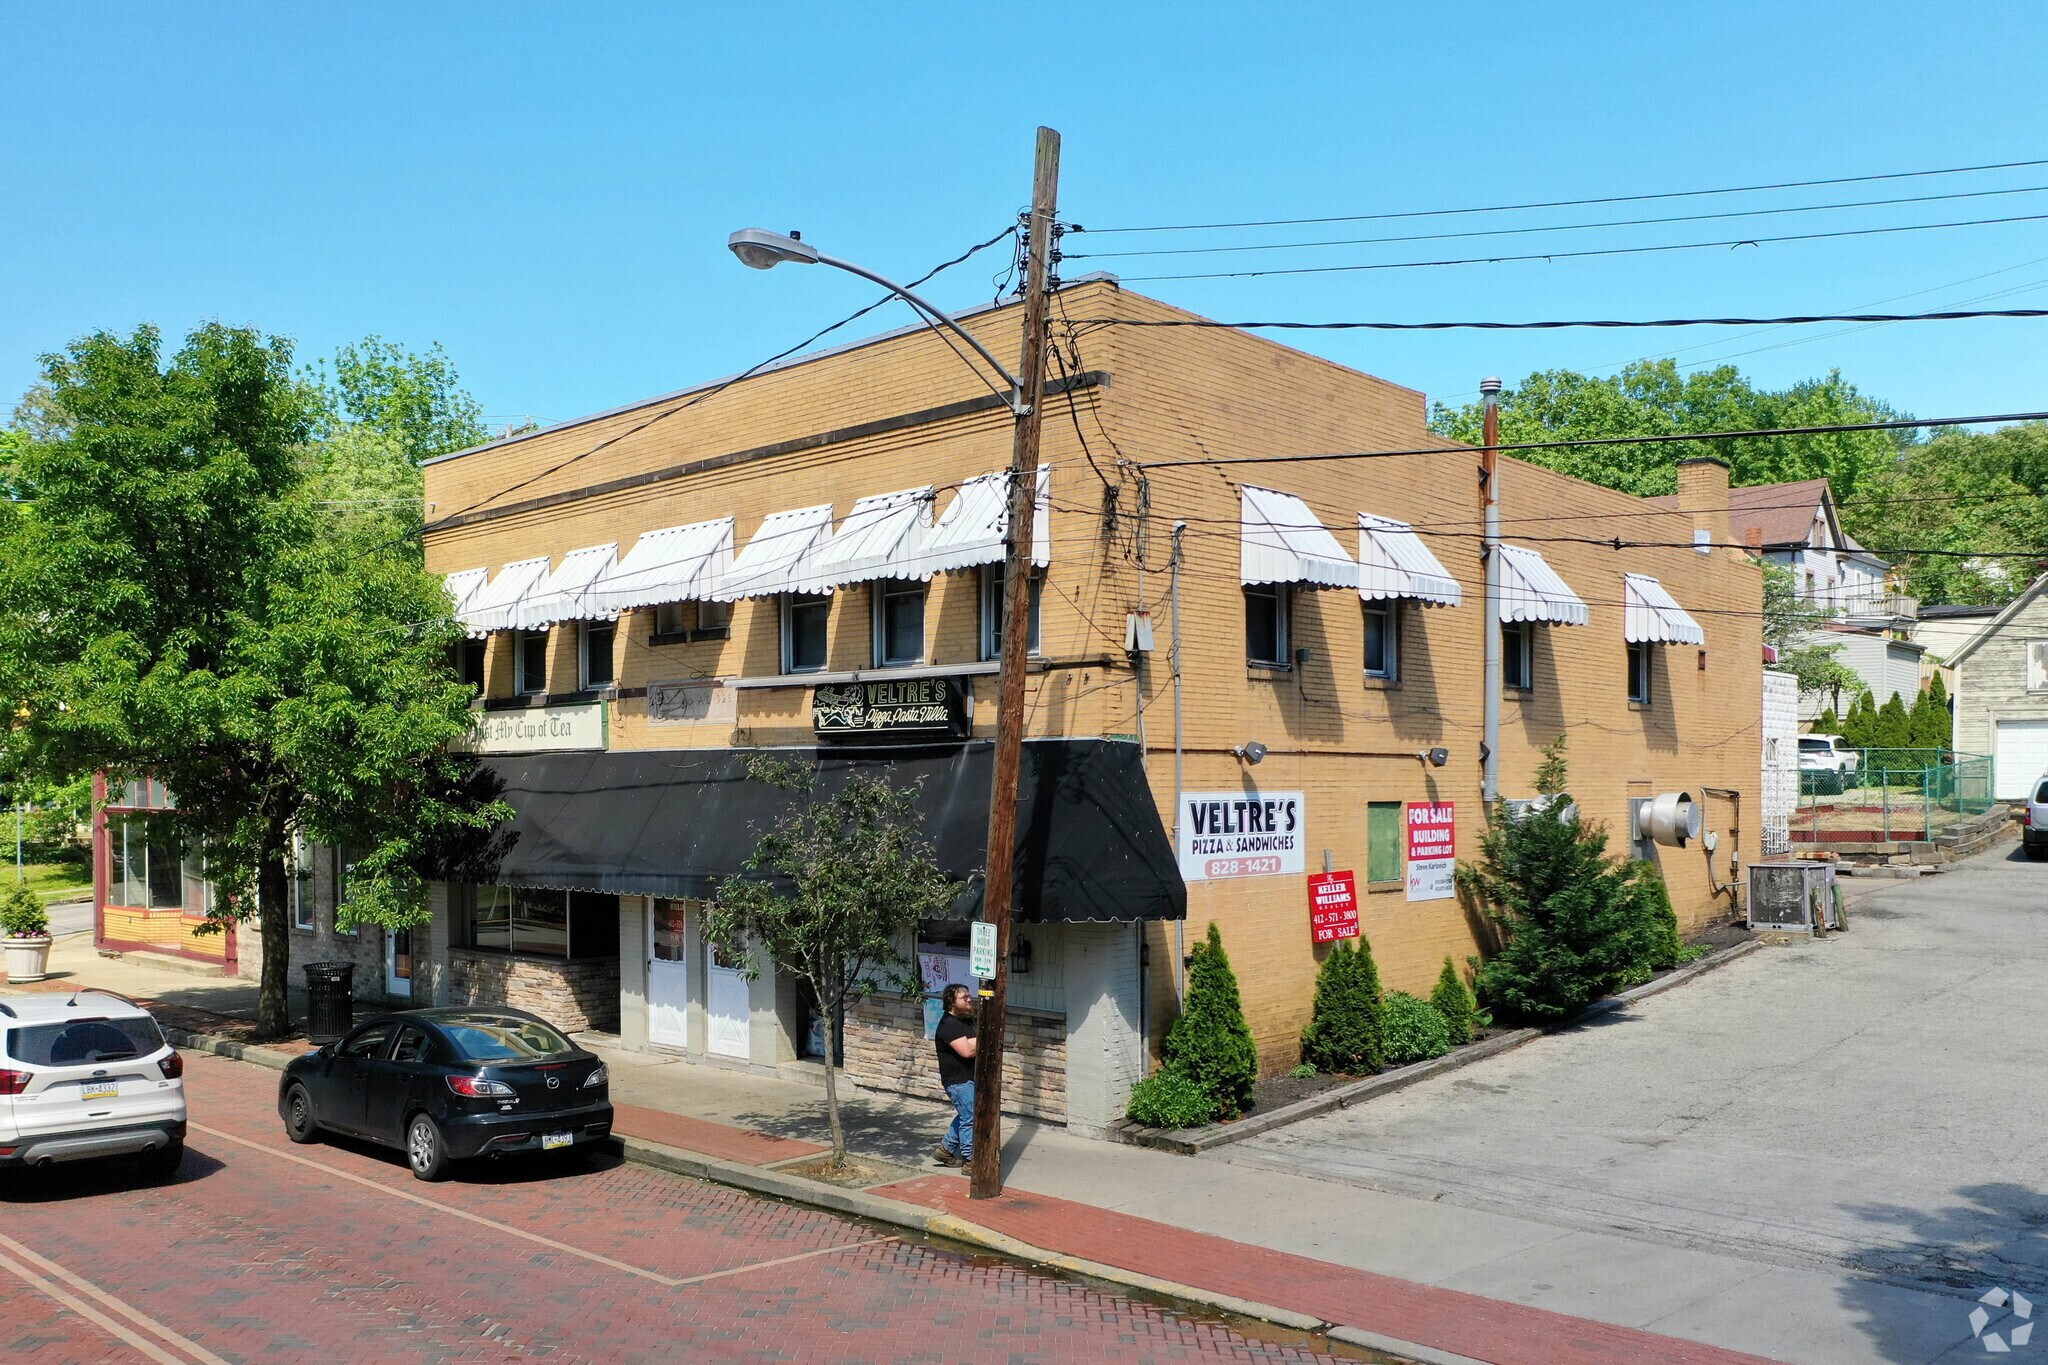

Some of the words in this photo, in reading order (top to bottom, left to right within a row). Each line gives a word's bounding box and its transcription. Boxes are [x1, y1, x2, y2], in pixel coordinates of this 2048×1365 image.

[867, 679, 946, 704] VELTRE'S
[864, 708, 892, 728] Pizza
[891, 707, 920, 726] Pasta
[920, 705, 948, 723] Villa
[495, 721, 513, 742] My
[515, 720, 536, 740] Cup
[538, 719, 547, 737] of
[550, 717, 572, 737] Tea
[1189, 799, 1297, 837] VELTRE'S
[1408, 808, 1429, 824] FOR
[1430, 807, 1453, 823] SALE
[1413, 829, 1450, 843] BUILDING
[1192, 838, 1223, 855] PIZZA
[1225, 839, 1235, 851] &
[1236, 835, 1294, 851] SANDWICHES
[1411, 847, 1416, 856] &
[1417, 845, 1441, 856] PARKING
[1443, 845, 1453, 854] LOT
[1211, 858, 1277, 874] 828-1421
[1318, 883, 1346, 894] KELLER
[1315, 893, 1352, 905] WILLIAMS
[976, 927, 990, 937] THREE
[1318, 929, 1333, 939] FOR
[1337, 926, 1355, 937] SALE
[976, 938, 990, 946] HOUR
[974, 946, 993, 957] PARKING
